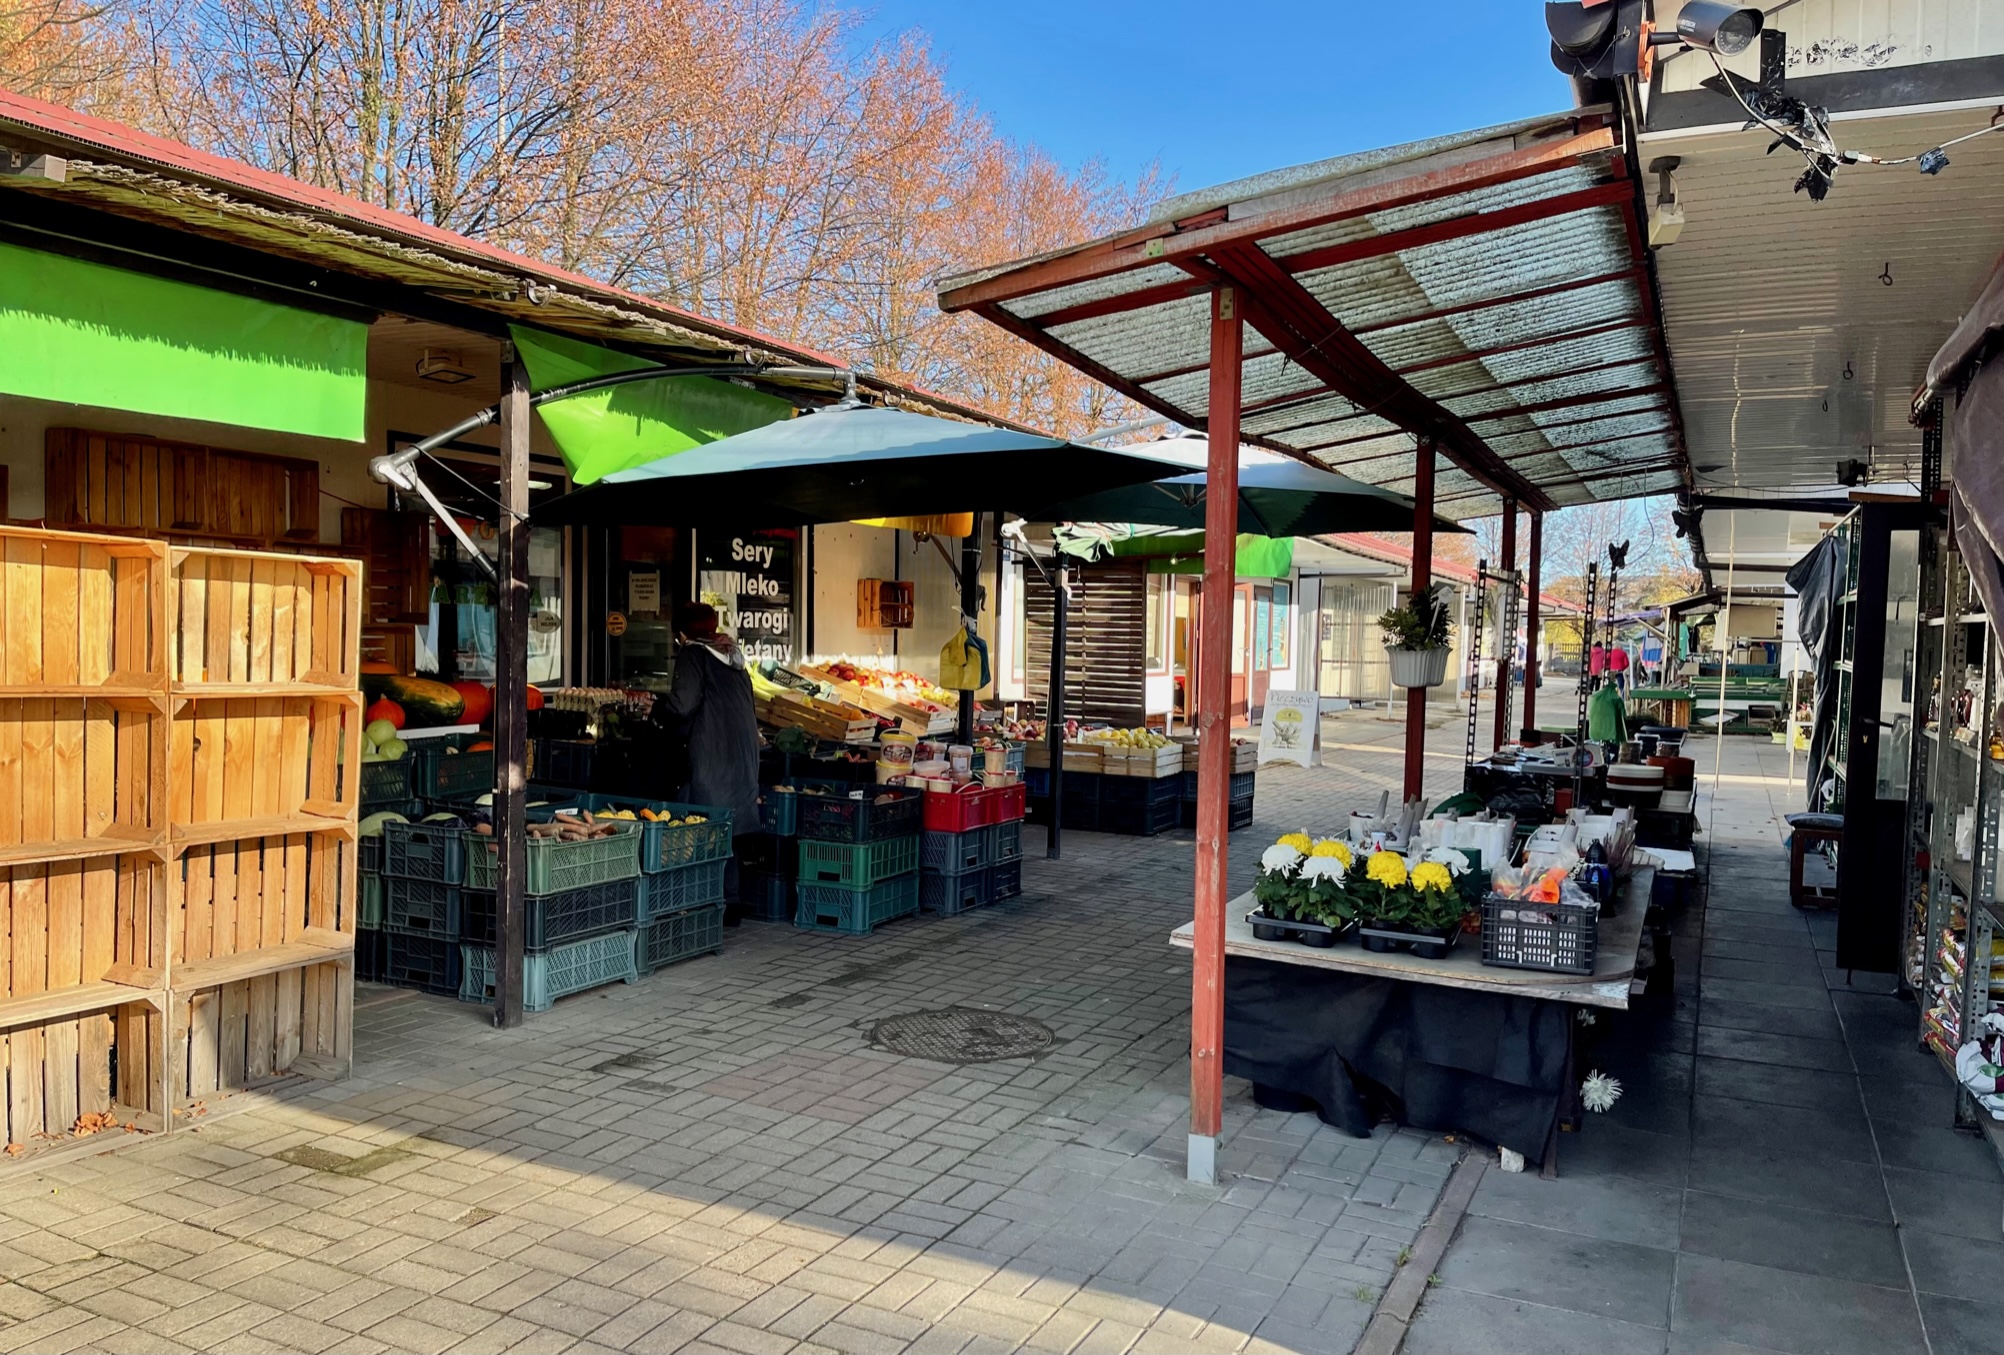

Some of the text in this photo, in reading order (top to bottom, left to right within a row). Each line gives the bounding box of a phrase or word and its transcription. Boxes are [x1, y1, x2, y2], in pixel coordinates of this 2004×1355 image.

[732, 537, 774, 569] Sery
[725, 571, 779, 597] Mleko
[714, 605, 788, 635] Twarogi
[738, 638, 793, 667] ietany
